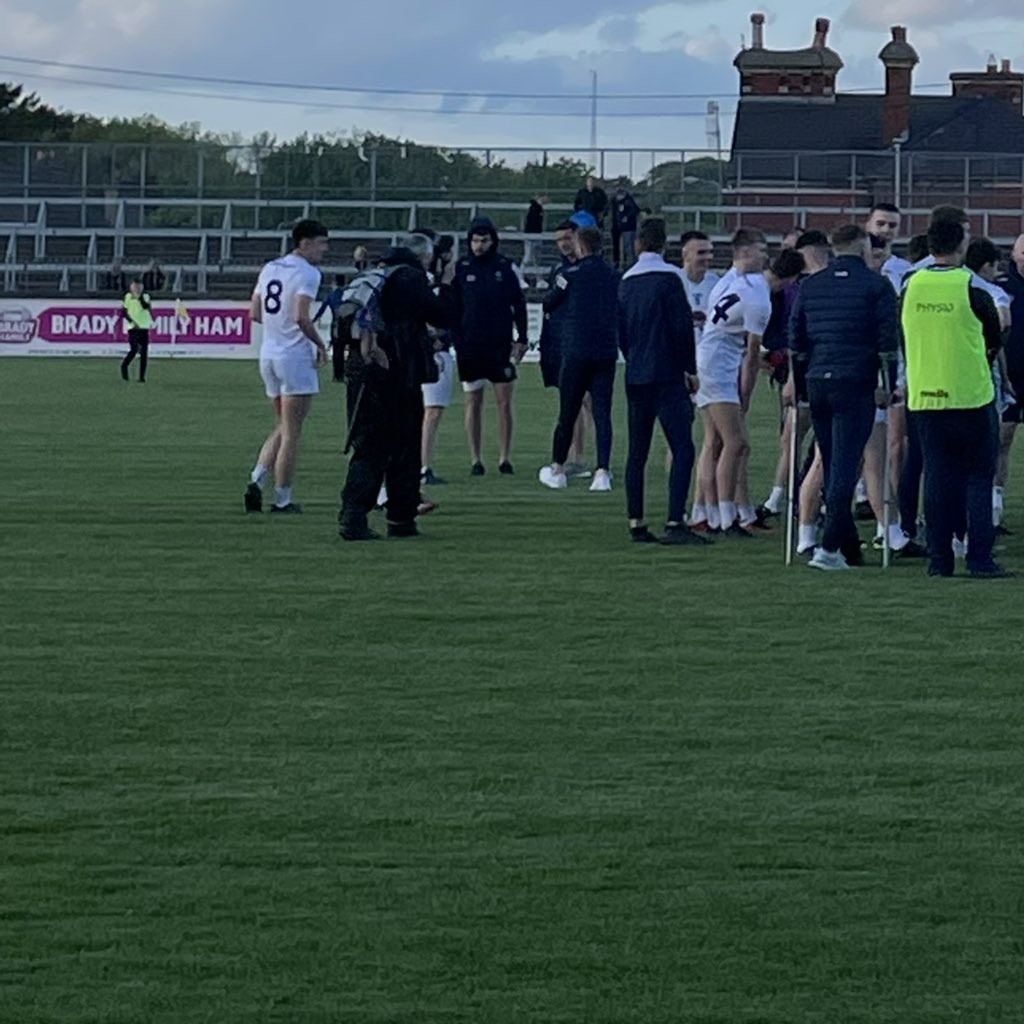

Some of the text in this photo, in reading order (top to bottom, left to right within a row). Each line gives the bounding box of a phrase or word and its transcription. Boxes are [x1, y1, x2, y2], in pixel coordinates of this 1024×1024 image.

[264, 279, 283, 315] 8
[712, 293, 741, 325] 4
[51, 314, 119, 335] BRADY
[194, 316, 243, 336] HAM
